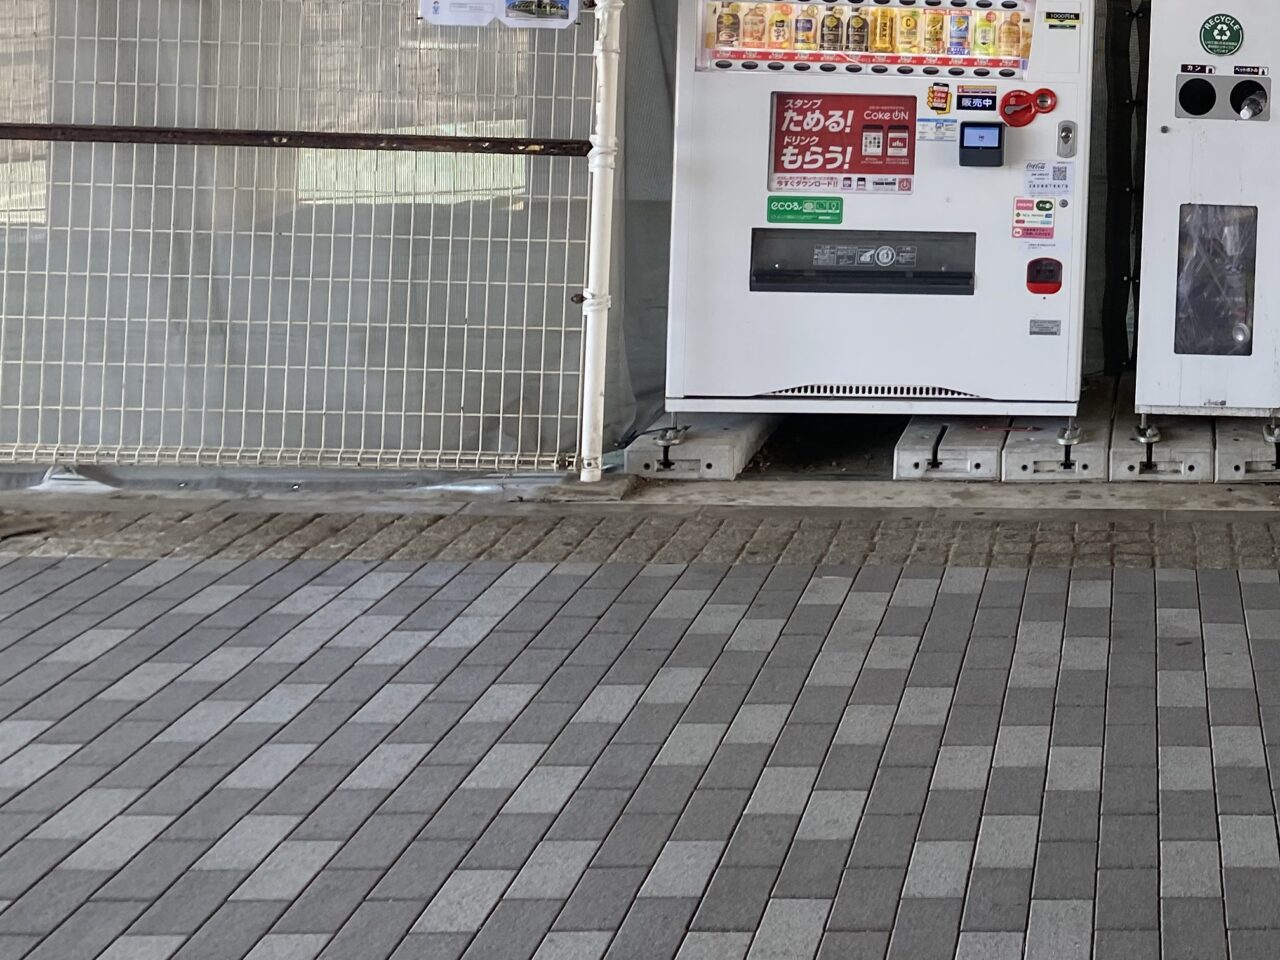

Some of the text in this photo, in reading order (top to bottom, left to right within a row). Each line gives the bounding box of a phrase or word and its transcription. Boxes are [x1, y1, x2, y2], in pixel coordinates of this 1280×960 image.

[1204, 15, 1241, 31] RECYCLE
[784, 98, 823, 108] スタンプ
[961, 98, 993, 108] 販売中
[863, 111, 909, 120] Coke ON
[781, 110, 855, 133] ためる!
[783, 136, 819, 145] ドリンク
[780, 146, 853, 170] もらう!
